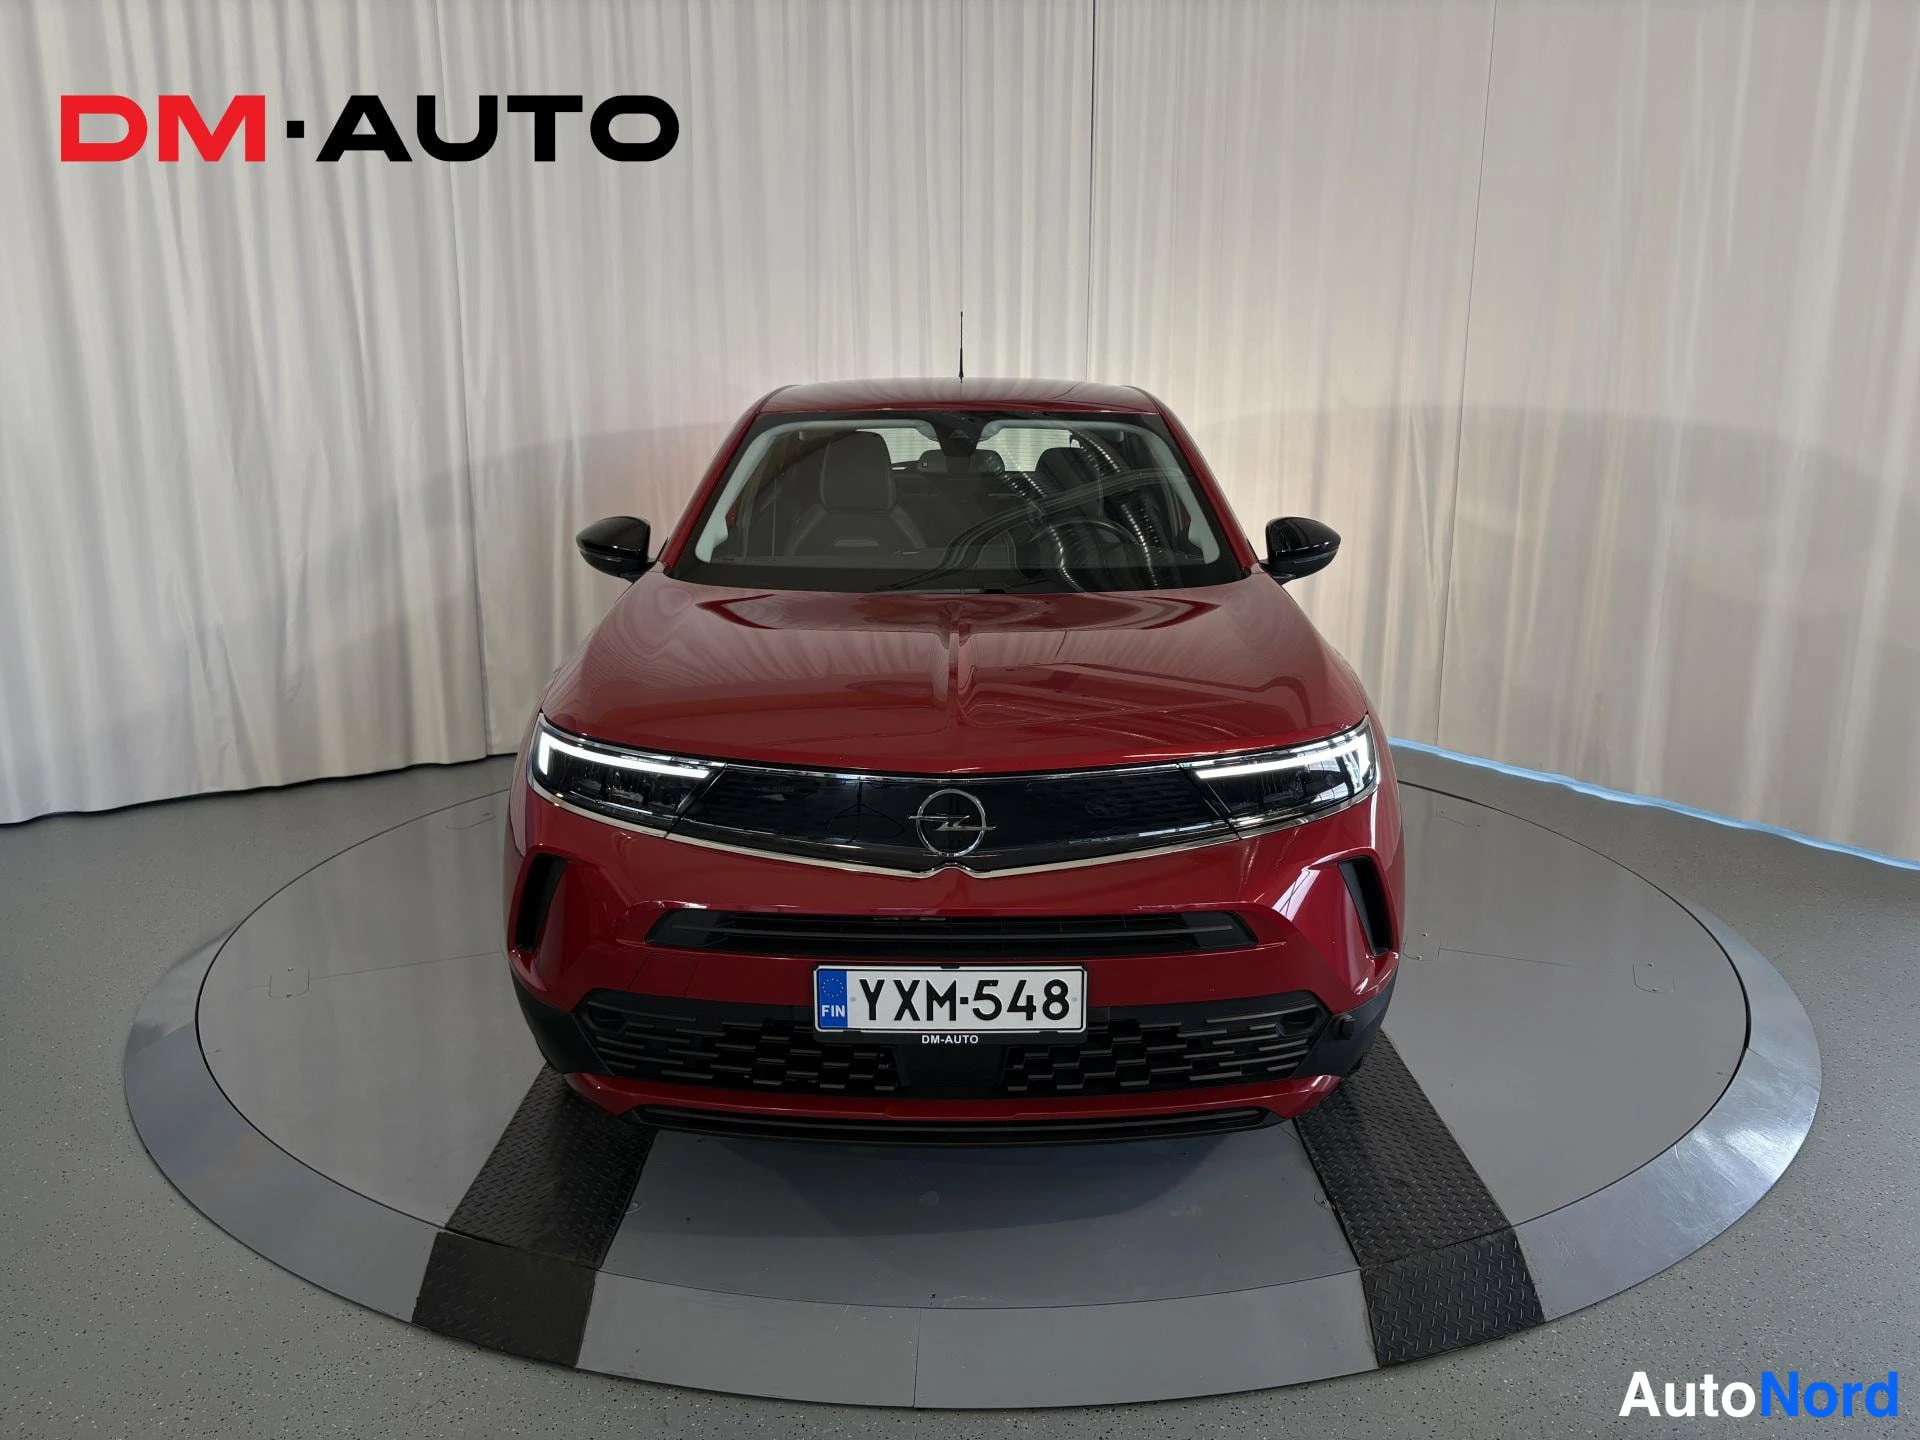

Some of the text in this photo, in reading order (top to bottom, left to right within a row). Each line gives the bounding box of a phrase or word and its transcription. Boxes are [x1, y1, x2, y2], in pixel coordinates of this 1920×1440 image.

[859, 979, 1070, 1021] YXM-548
[821, 1004, 846, 1018] FIN
[921, 1035, 979, 1045] DM-AUTO
